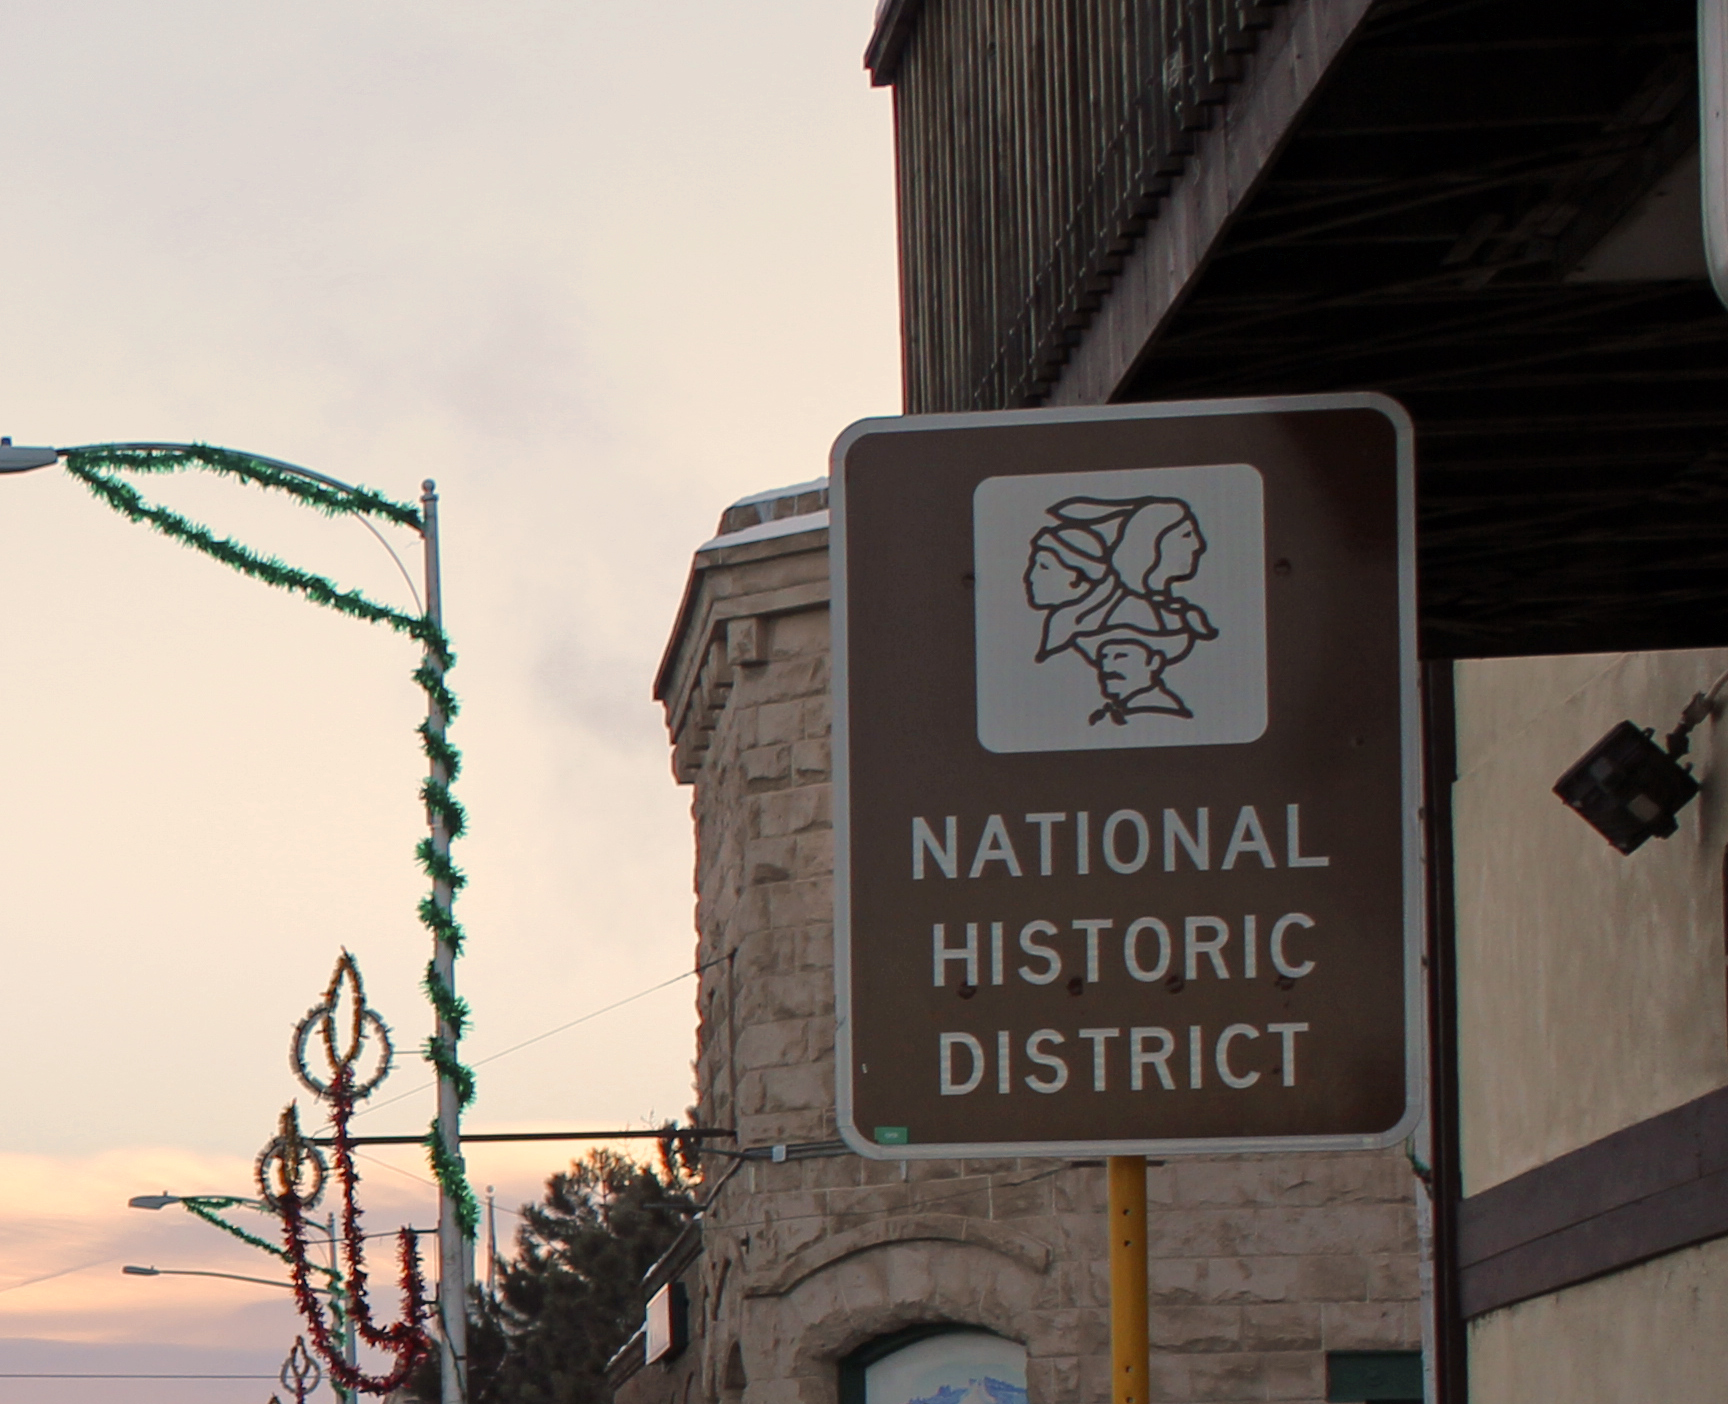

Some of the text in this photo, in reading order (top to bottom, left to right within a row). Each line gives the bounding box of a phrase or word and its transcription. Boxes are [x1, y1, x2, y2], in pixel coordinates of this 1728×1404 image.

[911, 804, 1330, 881] NATIONAL
[933, 912, 1317, 988] HISTORIC
[939, 1022, 1310, 1097] DISTRICT
